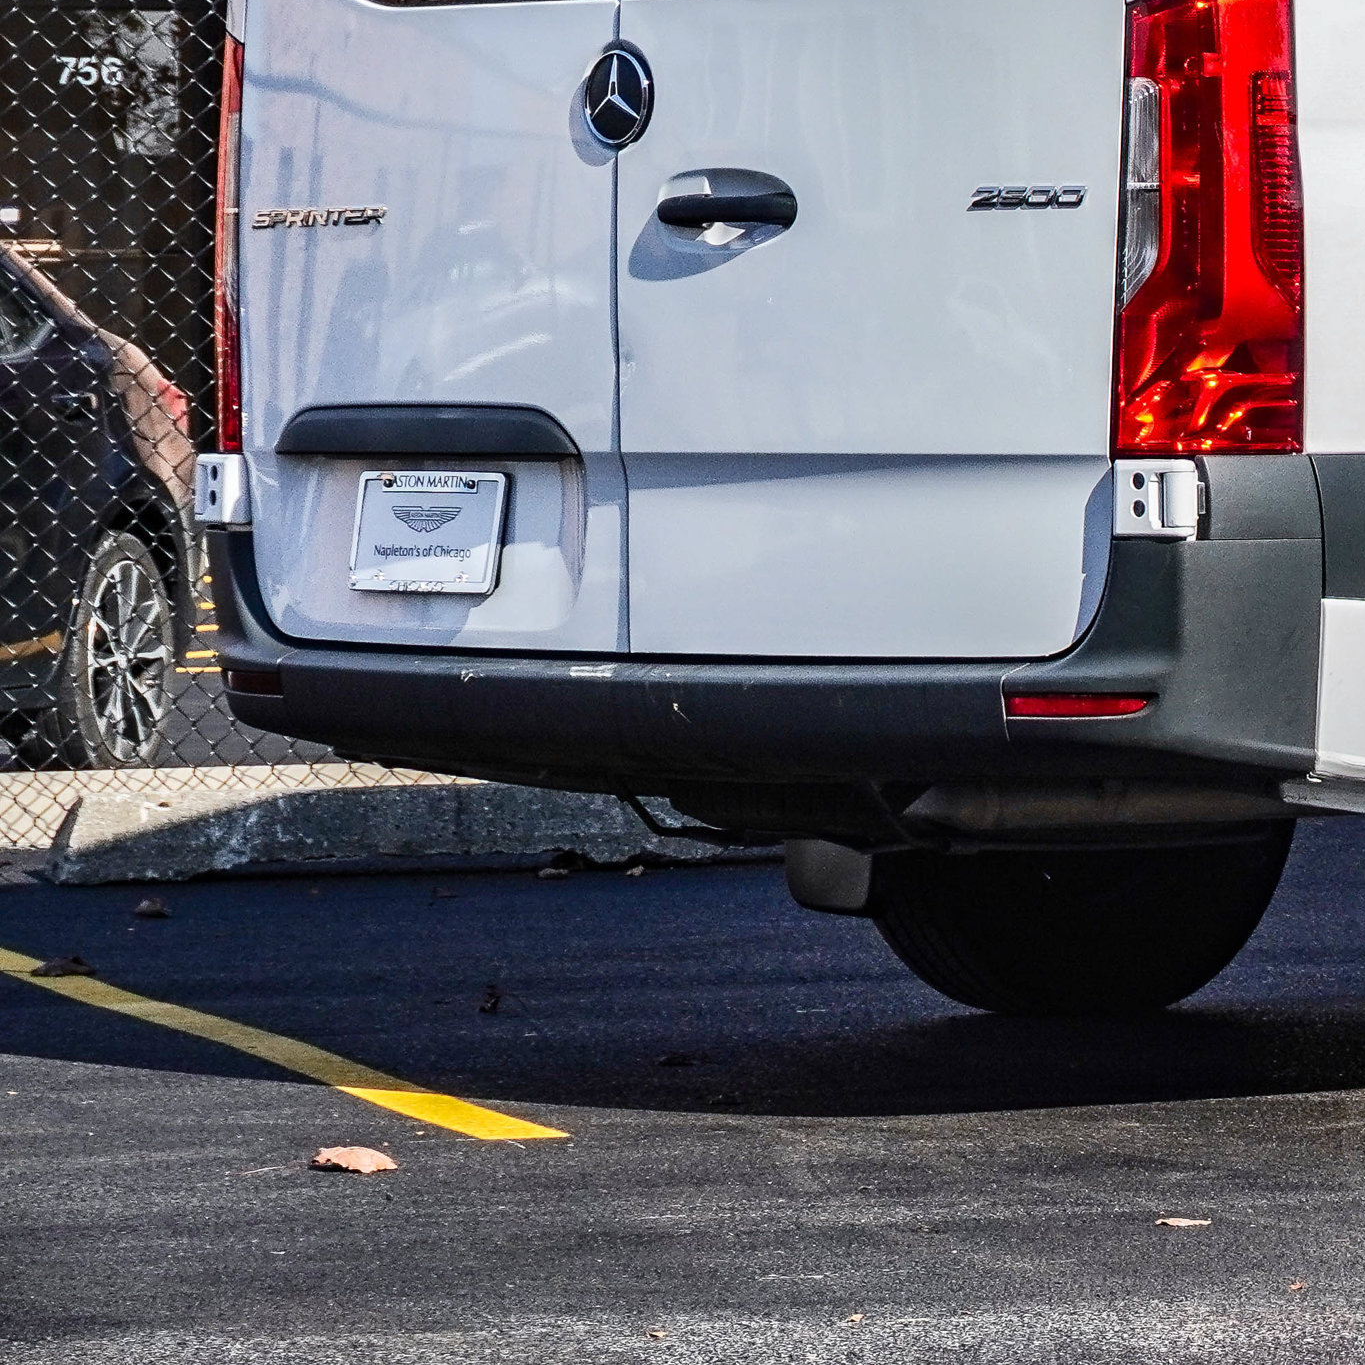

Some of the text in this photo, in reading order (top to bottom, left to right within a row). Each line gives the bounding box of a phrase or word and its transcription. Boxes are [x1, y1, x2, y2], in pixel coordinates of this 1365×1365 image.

[56, 56, 125, 86] 756
[966, 185, 1088, 212] 2500
[252, 205, 388, 229] SPRINTER
[426, 475, 468, 489] MARTIN
[374, 544, 471, 562] Napleton's of Chicago
